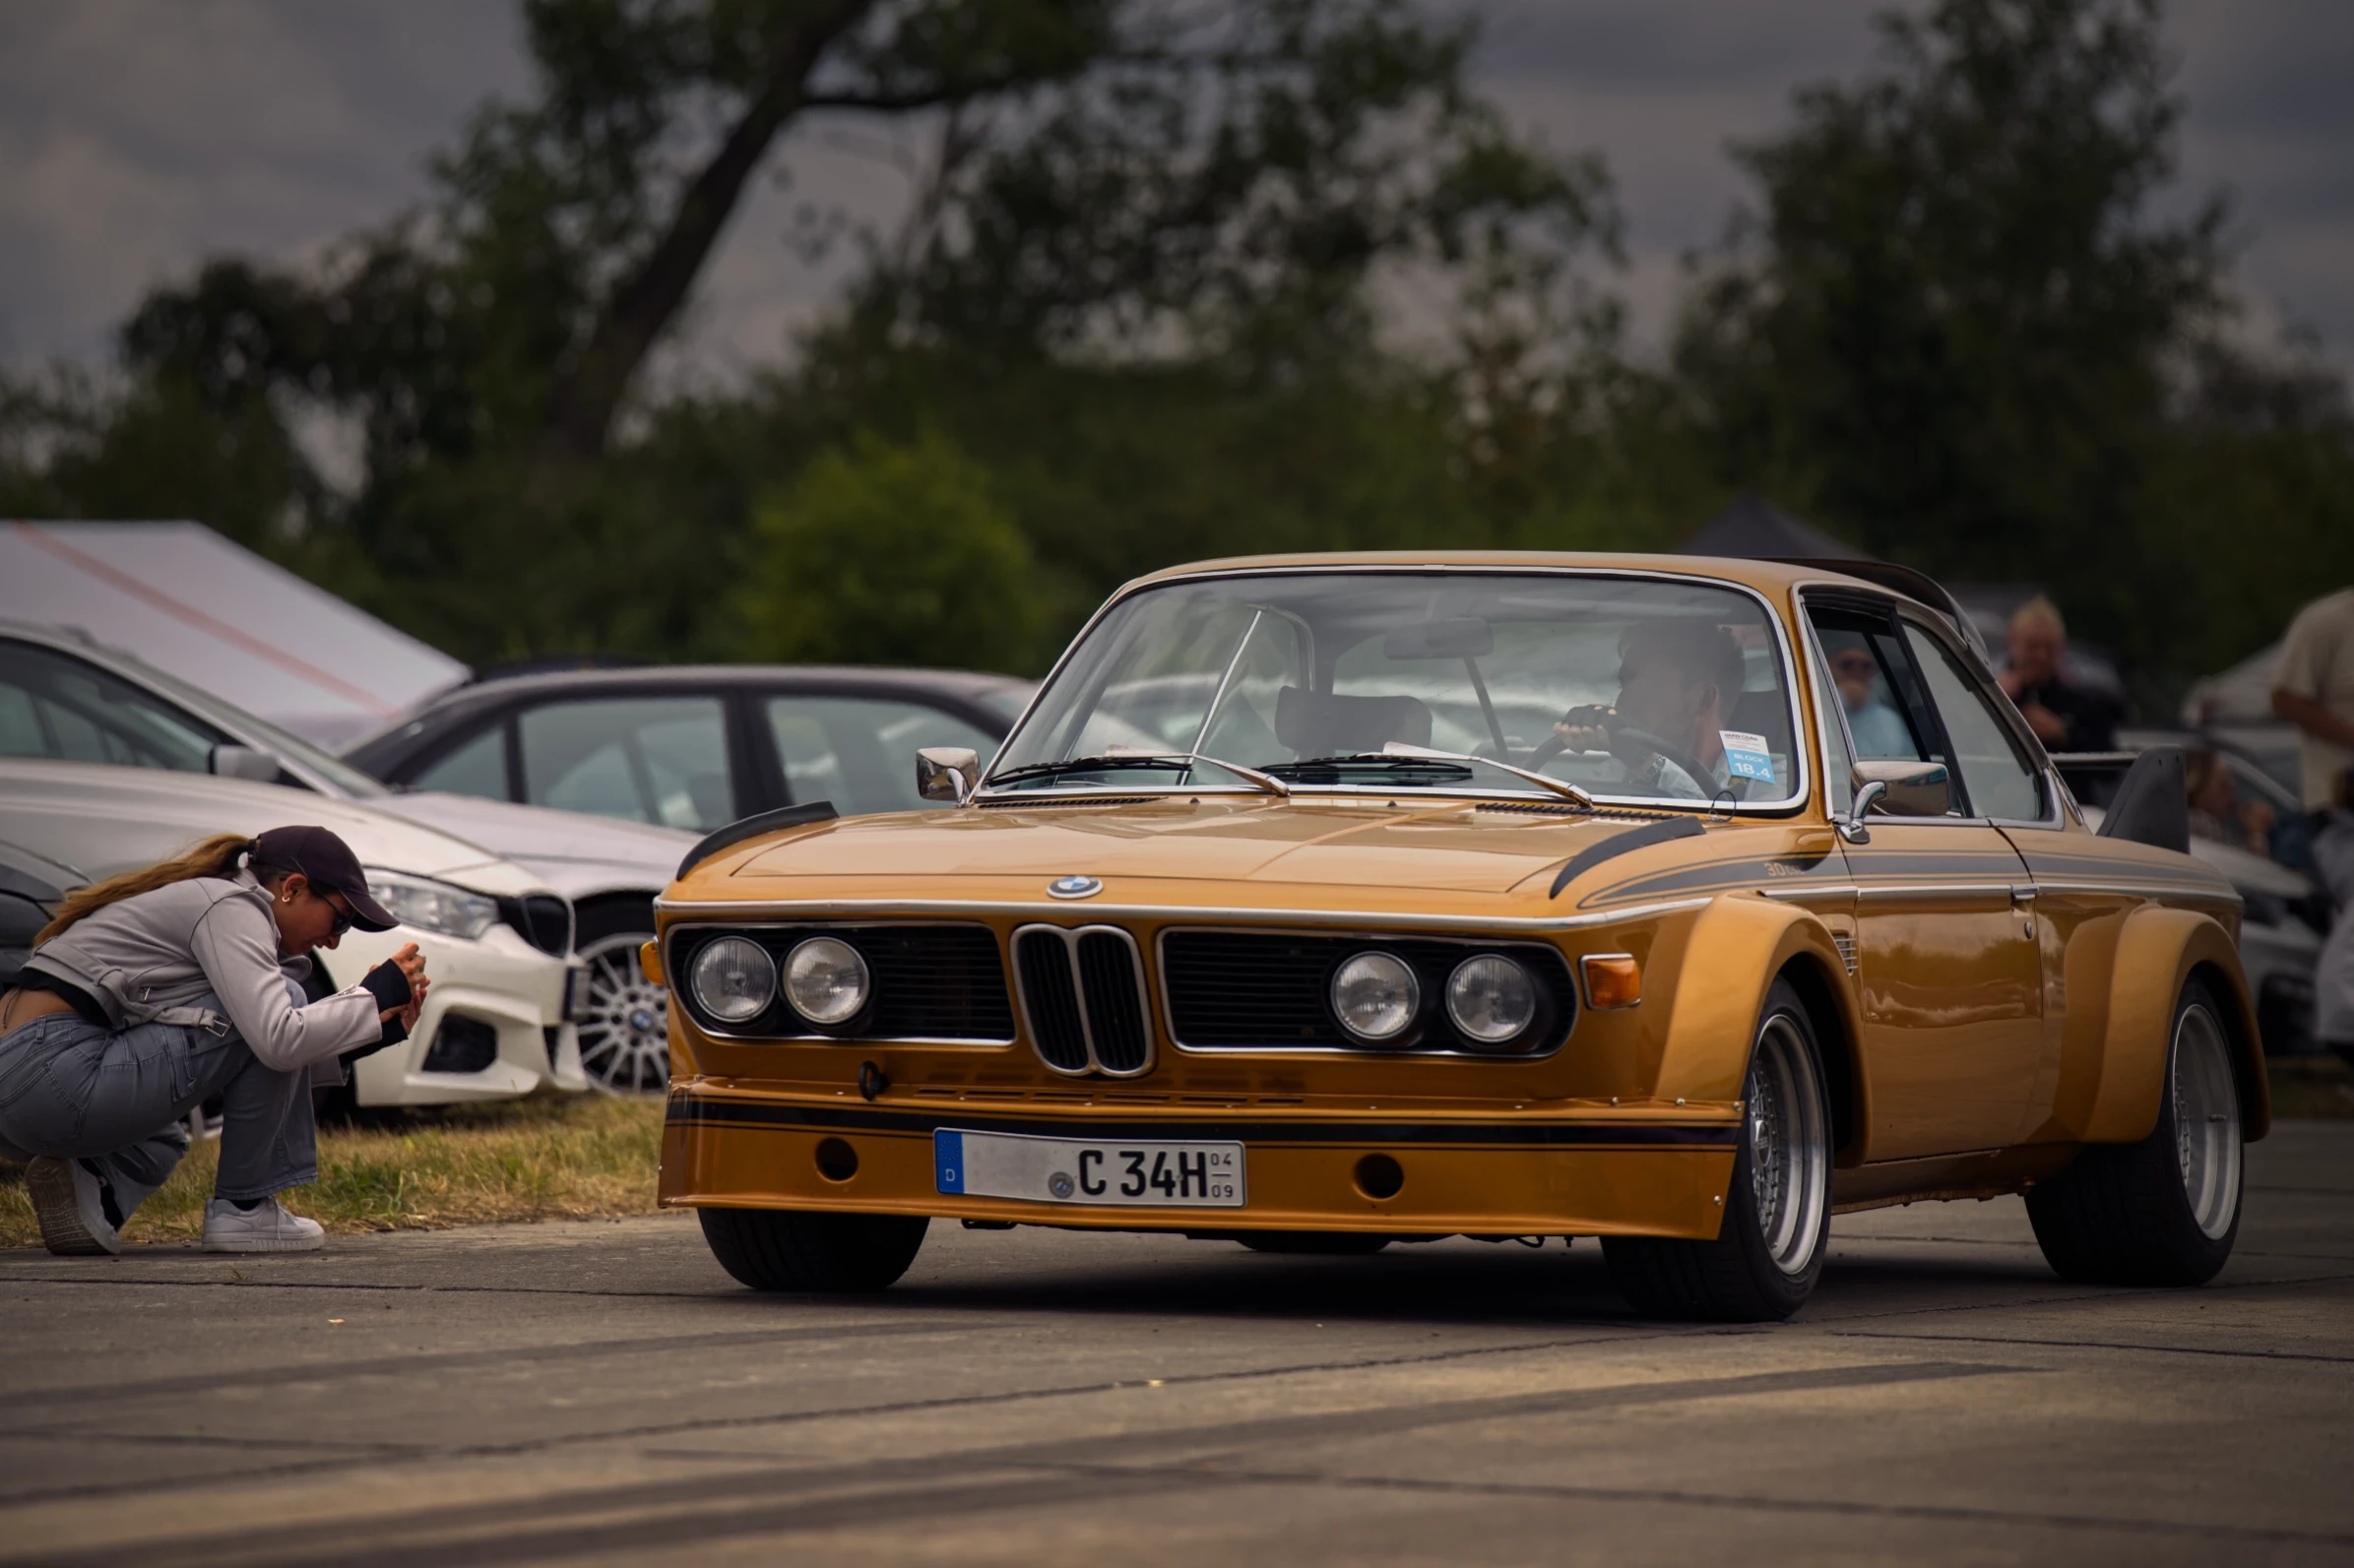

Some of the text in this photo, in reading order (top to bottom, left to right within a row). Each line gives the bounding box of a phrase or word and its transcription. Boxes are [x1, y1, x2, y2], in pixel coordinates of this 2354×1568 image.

[1734, 753, 1765, 764] BLOCK
[1735, 762, 1771, 779] 18.4
[1210, 1153, 1232, 1166] 04
[945, 1168, 956, 1182] D
[1079, 1150, 1208, 1198] C 34H
[1211, 1184, 1234, 1198] 09
